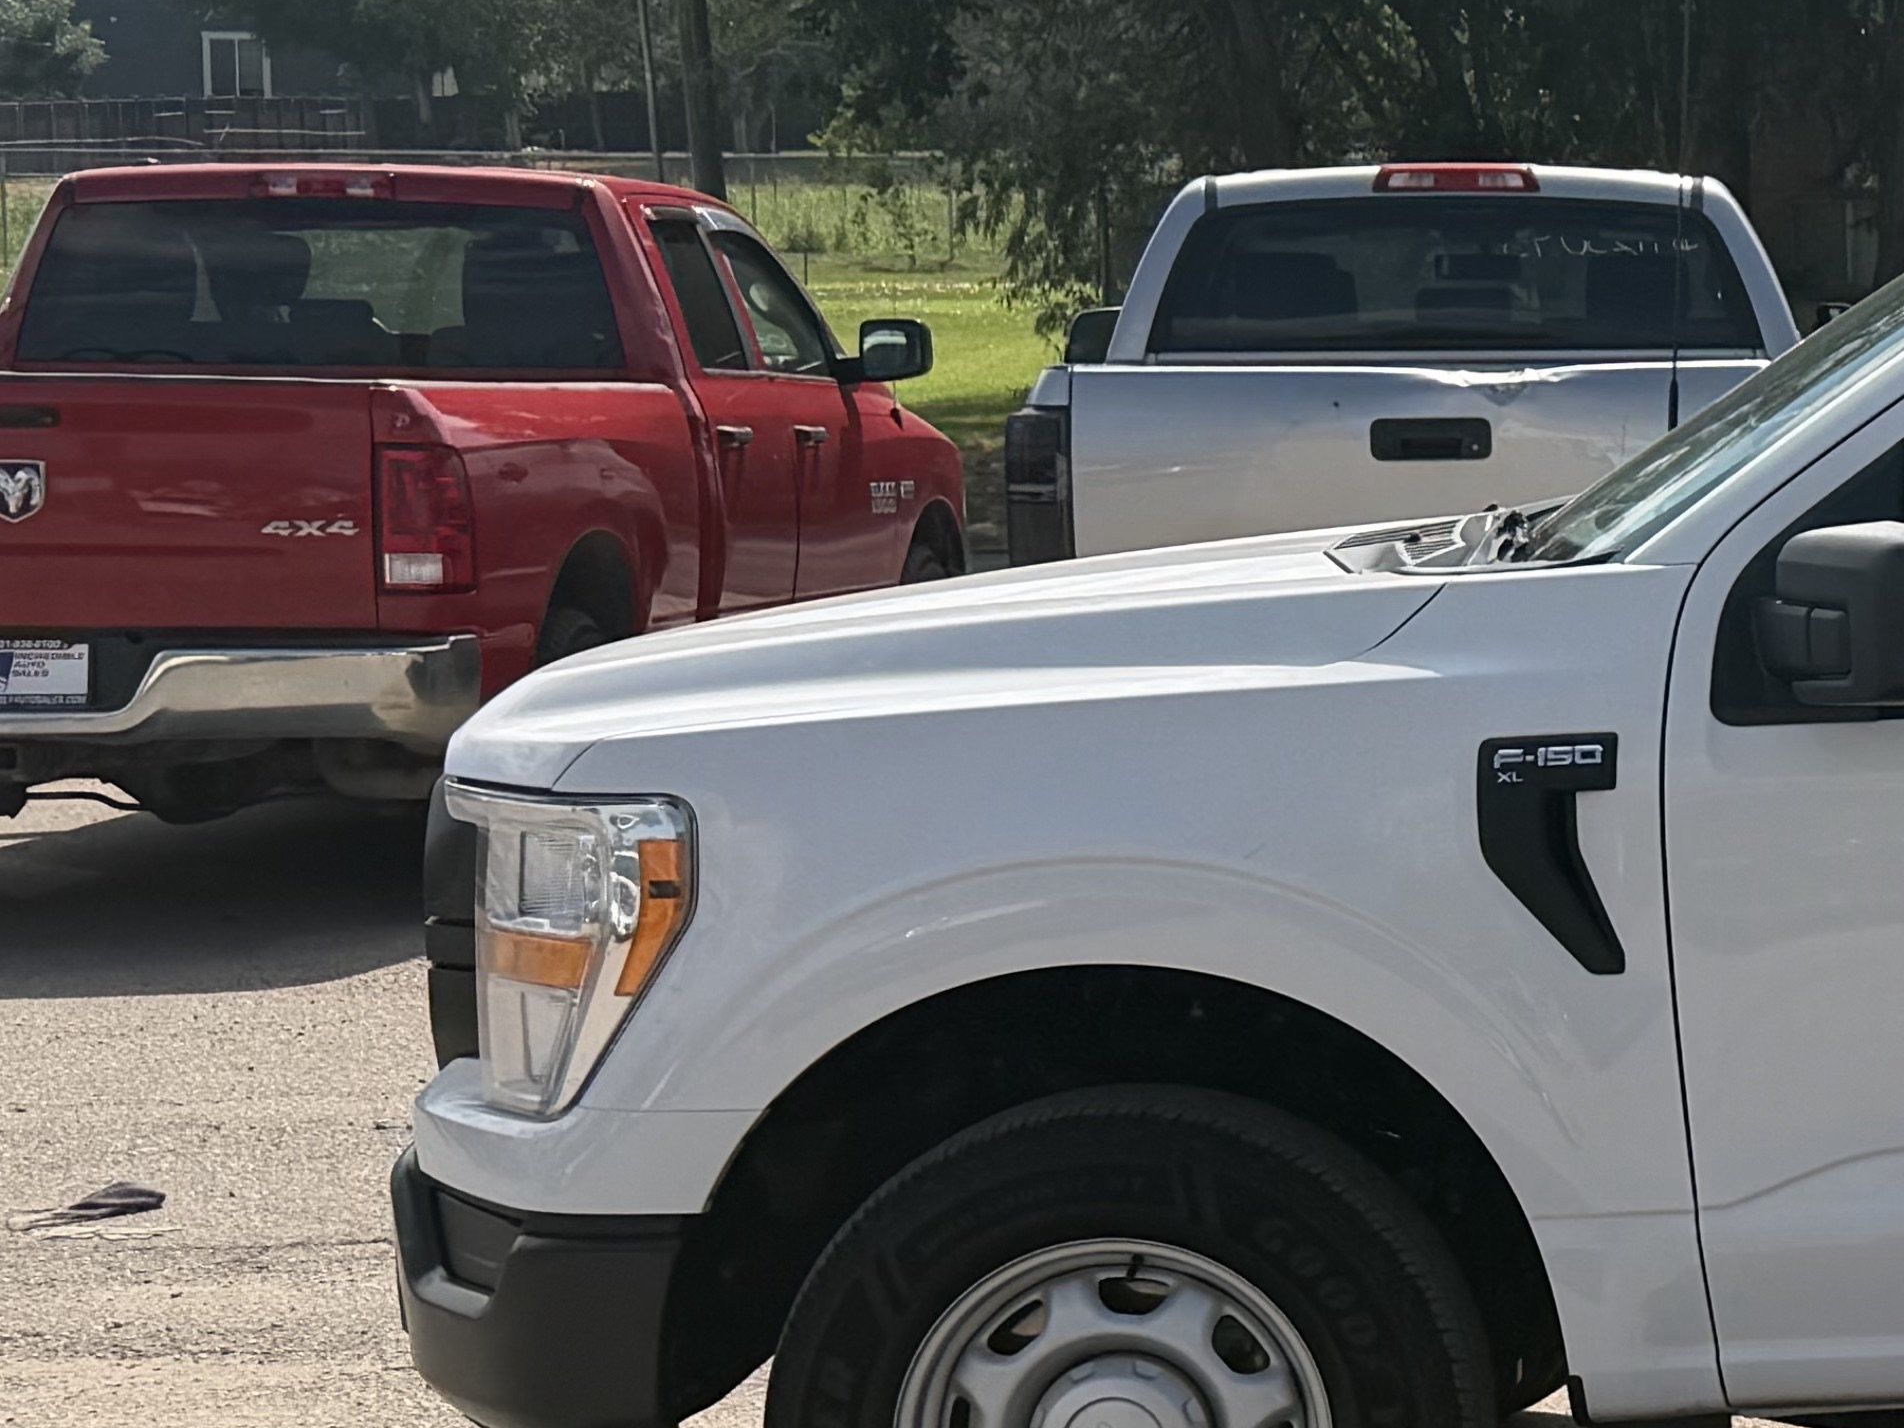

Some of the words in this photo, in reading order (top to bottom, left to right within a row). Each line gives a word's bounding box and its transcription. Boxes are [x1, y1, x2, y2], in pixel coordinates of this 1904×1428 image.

[260, 520, 360, 537] 4X4
[1493, 744, 1604, 769] F-150
[1497, 771, 1524, 784] XL
